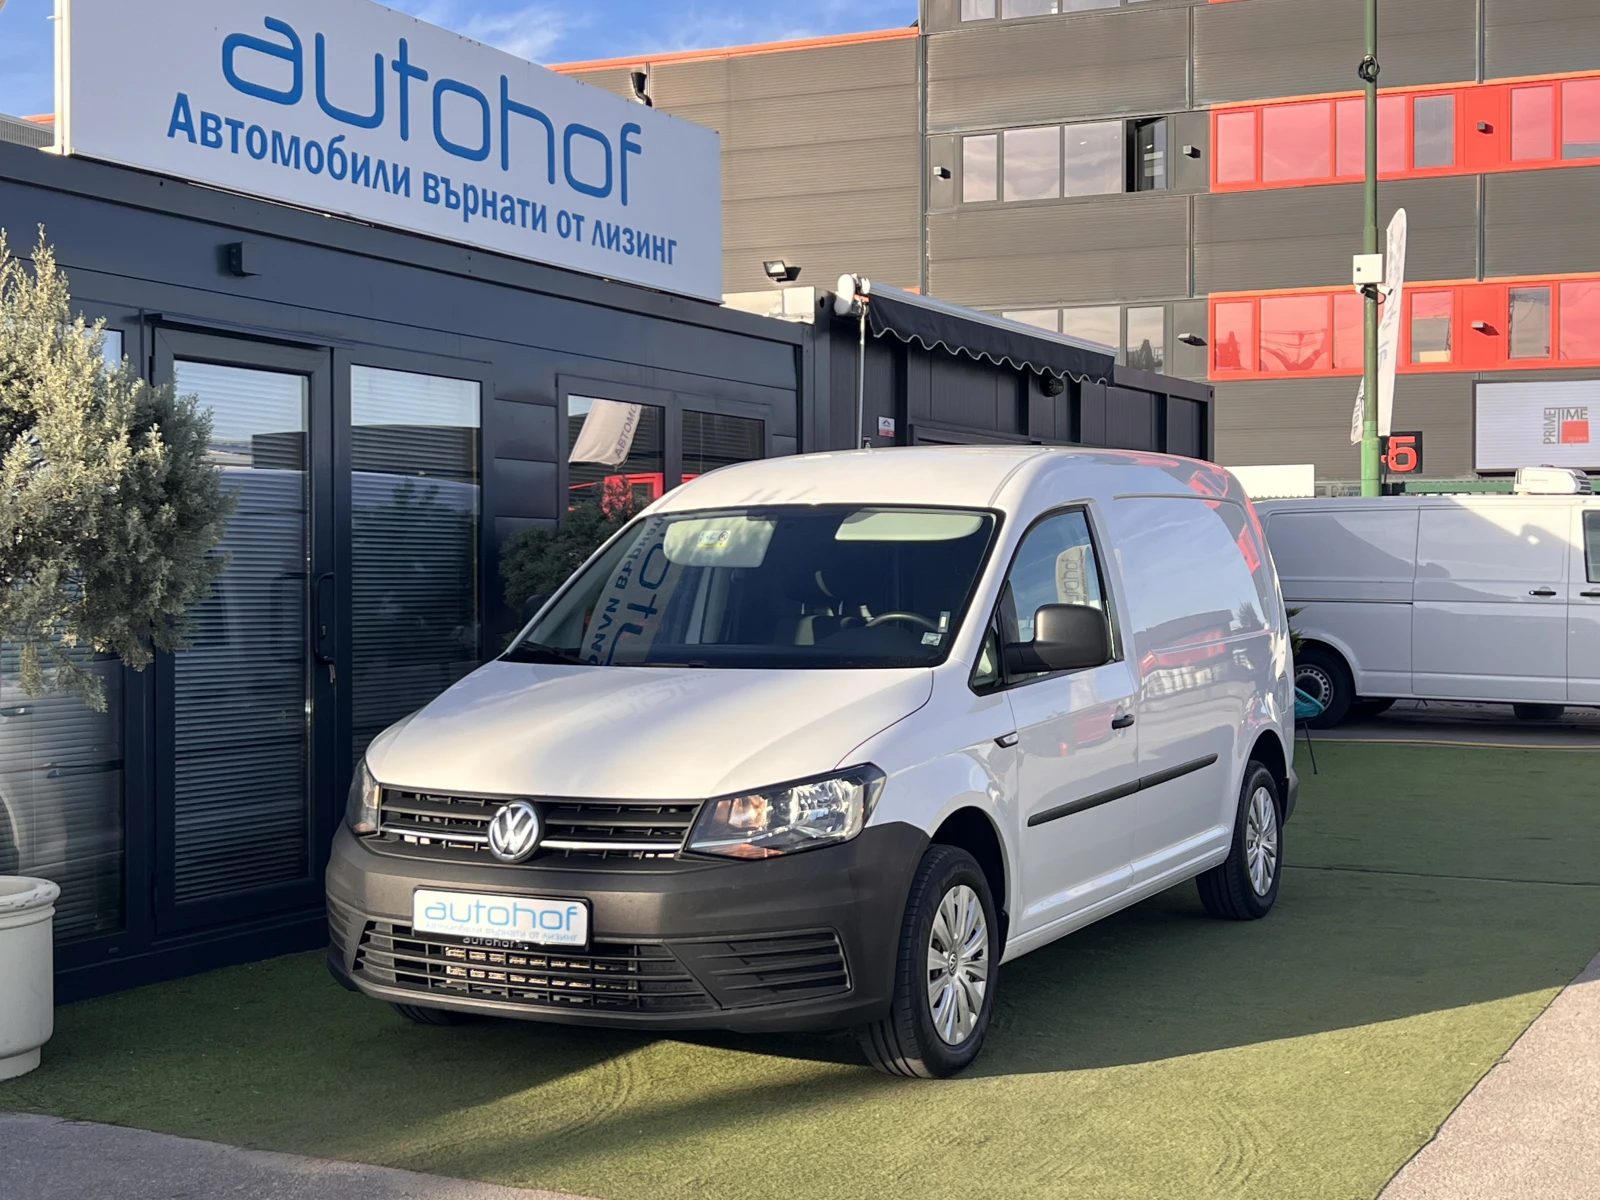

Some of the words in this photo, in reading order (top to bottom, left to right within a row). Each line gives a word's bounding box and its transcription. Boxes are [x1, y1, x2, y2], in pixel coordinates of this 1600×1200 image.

[167, 92, 410, 198] Автомобили
[423, 171, 547, 233] върнати
[556, 209, 585, 242] от
[592, 219, 677, 265] лизинг
[222, 15, 642, 206] autohof
[425, 899, 578, 931] autohof
